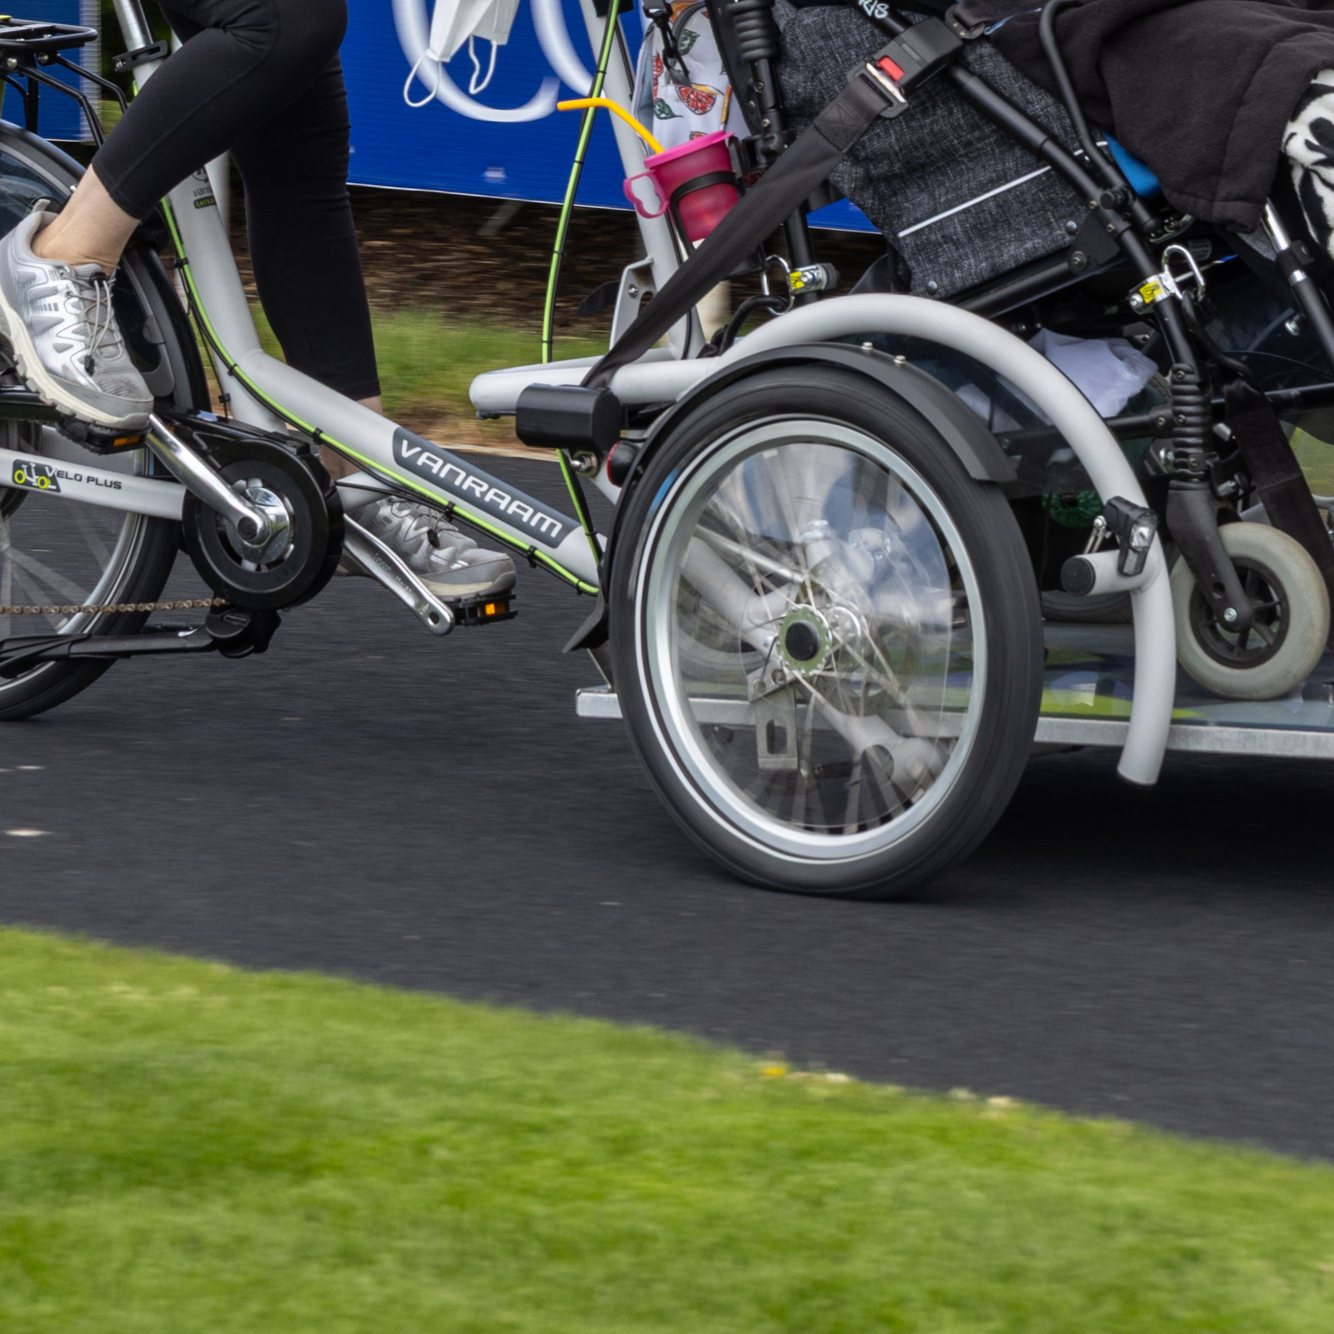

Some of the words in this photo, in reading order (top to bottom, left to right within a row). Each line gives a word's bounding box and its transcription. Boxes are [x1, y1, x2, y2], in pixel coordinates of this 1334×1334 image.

[45, 465, 83, 483] VELO
[87, 475, 123, 490] PLUS
[401, 439, 563, 539] VANRAAM
